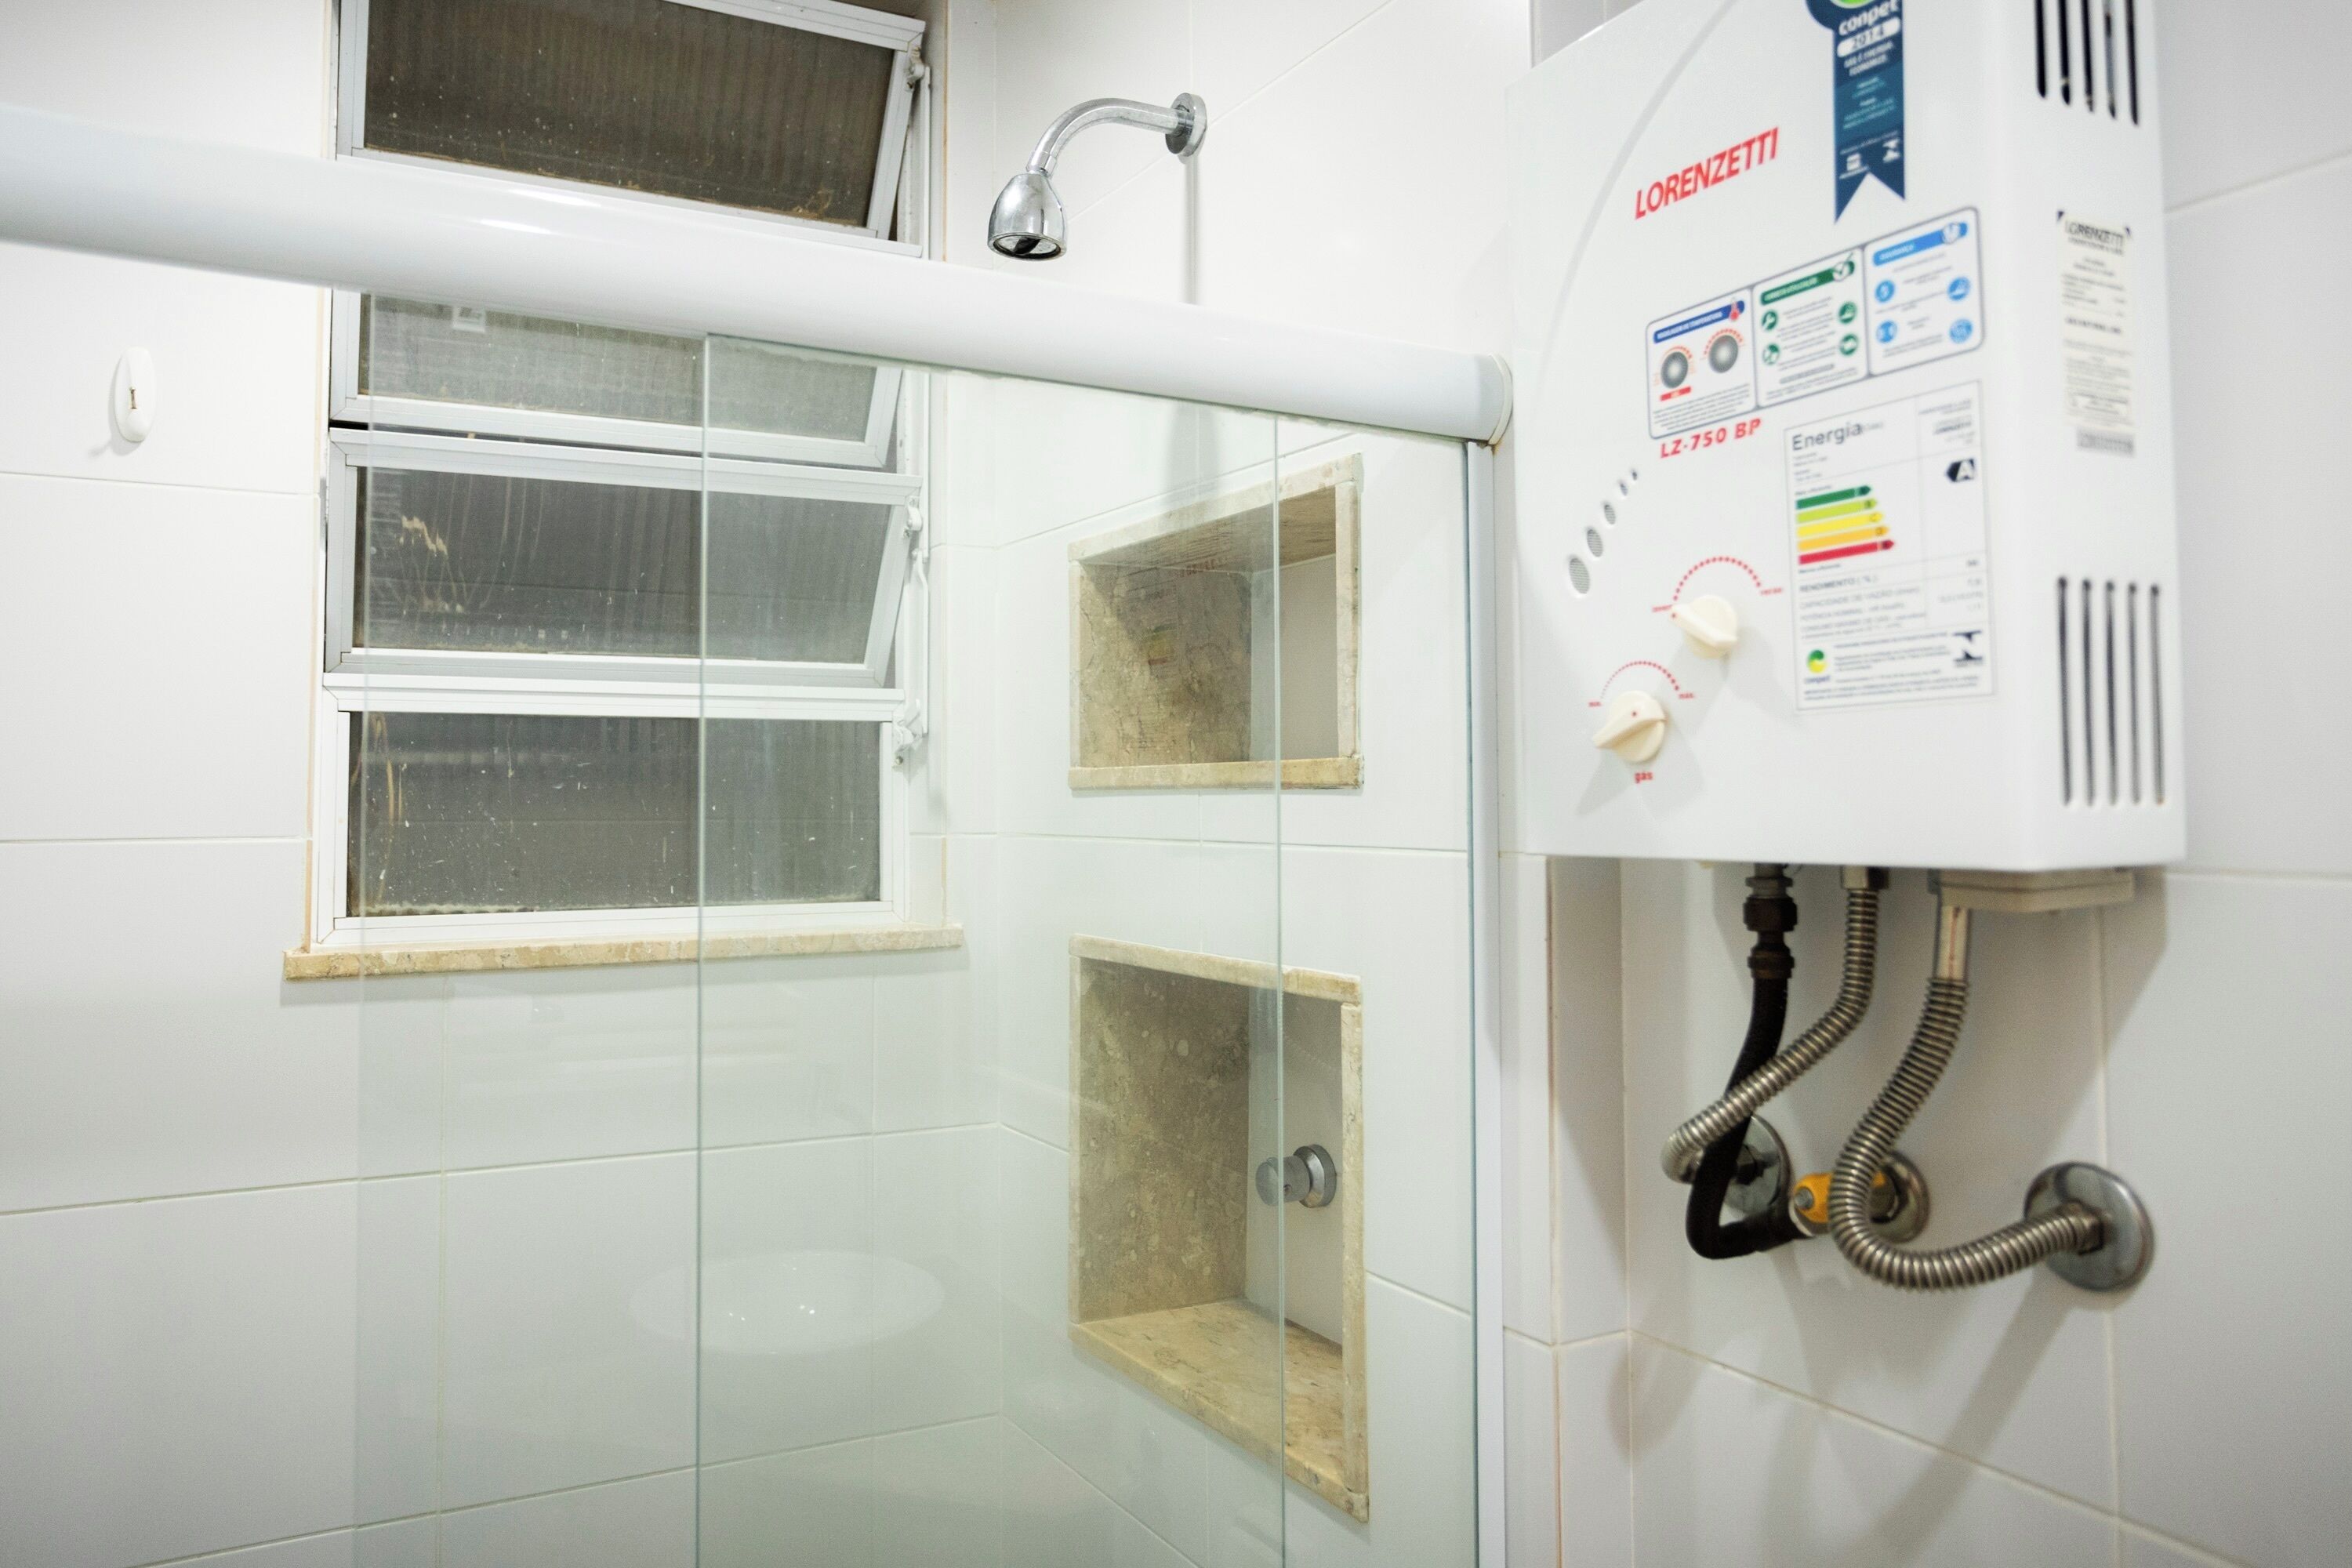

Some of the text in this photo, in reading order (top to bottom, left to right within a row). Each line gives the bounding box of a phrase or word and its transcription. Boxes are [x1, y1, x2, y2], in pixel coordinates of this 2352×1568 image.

[1635, 126, 1778, 220] LORENZETTI
[1661, 418, 1761, 459] LZ-750 BP
[1792, 422, 1864, 452] Energia
